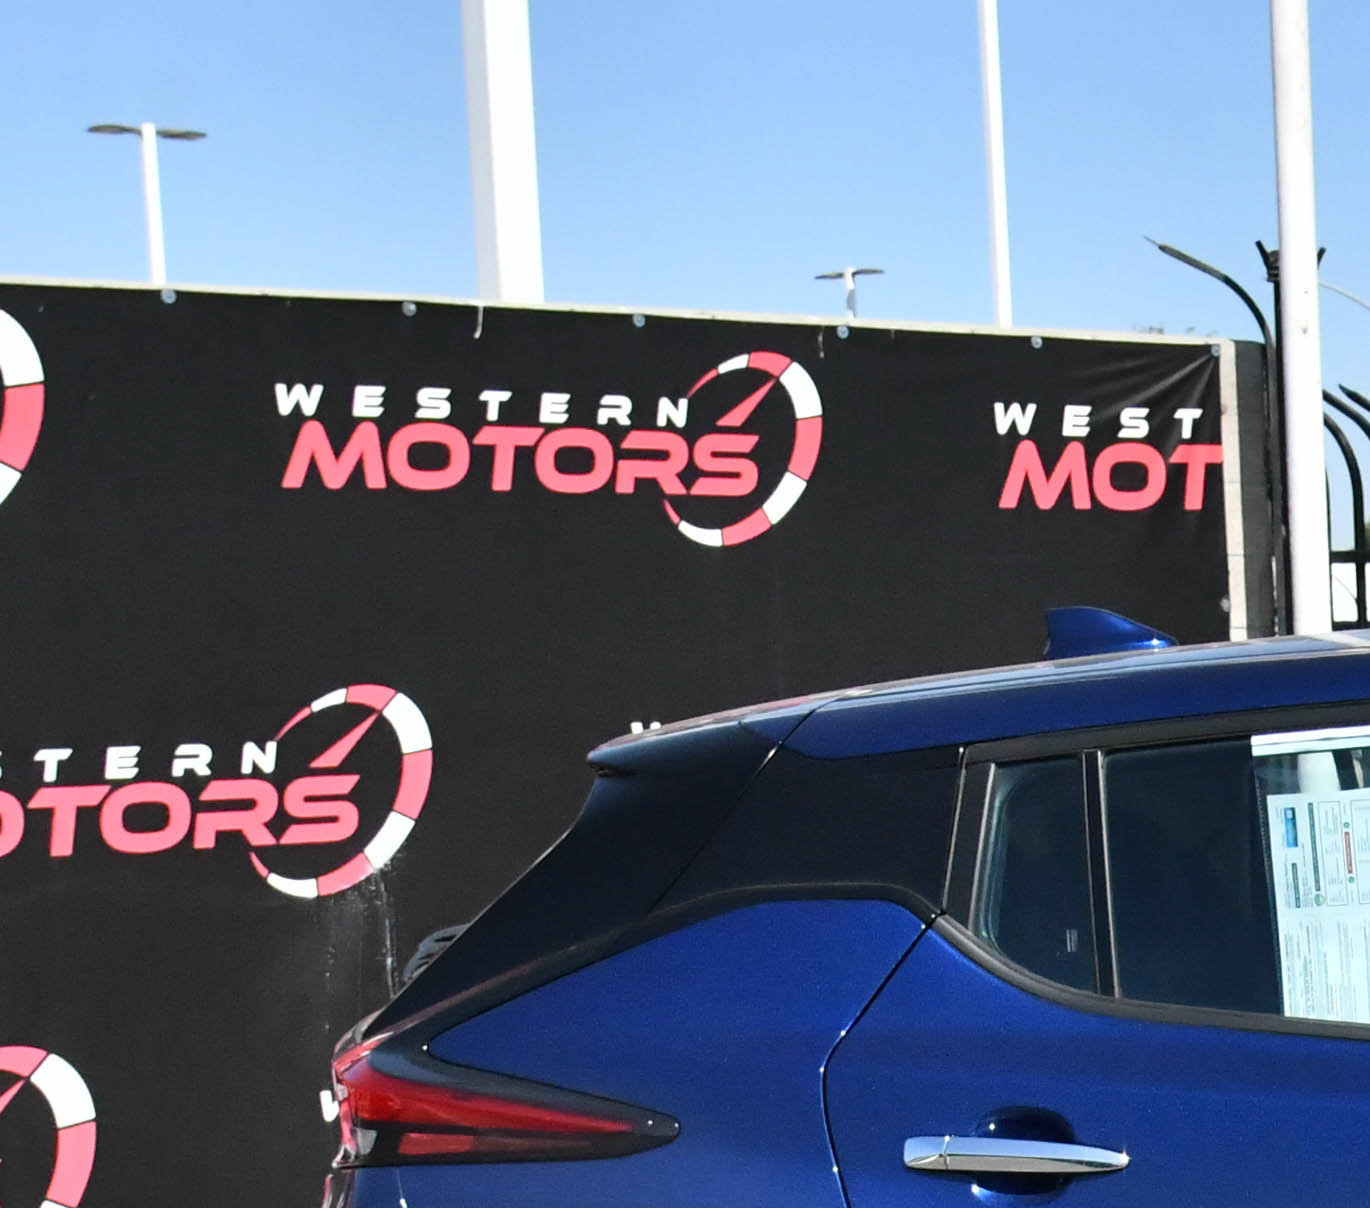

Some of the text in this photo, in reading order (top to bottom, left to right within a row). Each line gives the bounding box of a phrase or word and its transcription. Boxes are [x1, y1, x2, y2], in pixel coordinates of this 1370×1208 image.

[274, 382, 688, 428] WESTERN
[993, 402, 1203, 439] WEST
[281, 420, 760, 497] MOTORS
[998, 439, 1224, 512] MOT
[0, 741, 278, 784] TERN
[0, 773, 361, 859] TORS
